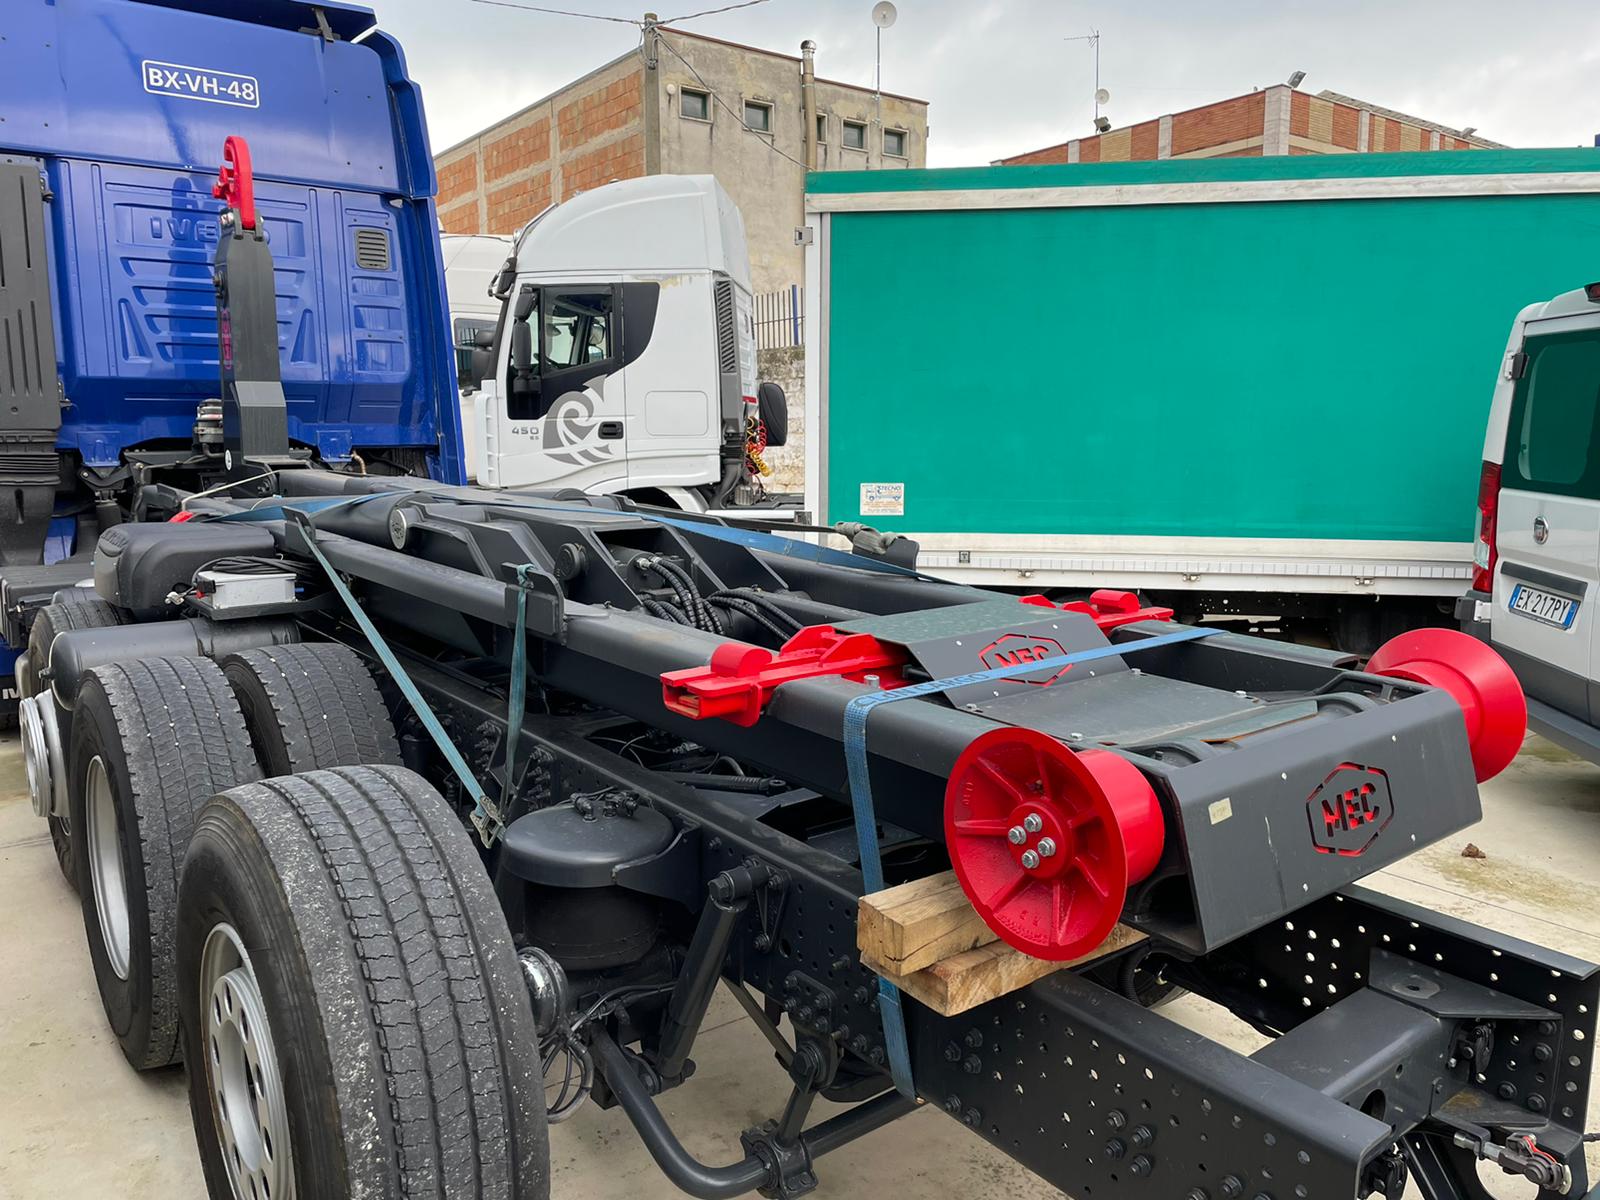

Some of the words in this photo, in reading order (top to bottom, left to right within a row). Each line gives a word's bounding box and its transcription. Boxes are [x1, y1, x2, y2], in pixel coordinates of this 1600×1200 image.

[148, 67, 256, 101] BX-VH-48
[511, 427, 539, 435] 450
[1515, 589, 1534, 611] EX
[1531, 594, 1570, 621] 217PY
[913, 673, 990, 692] CARGO
[1321, 782, 1380, 838] MEC
